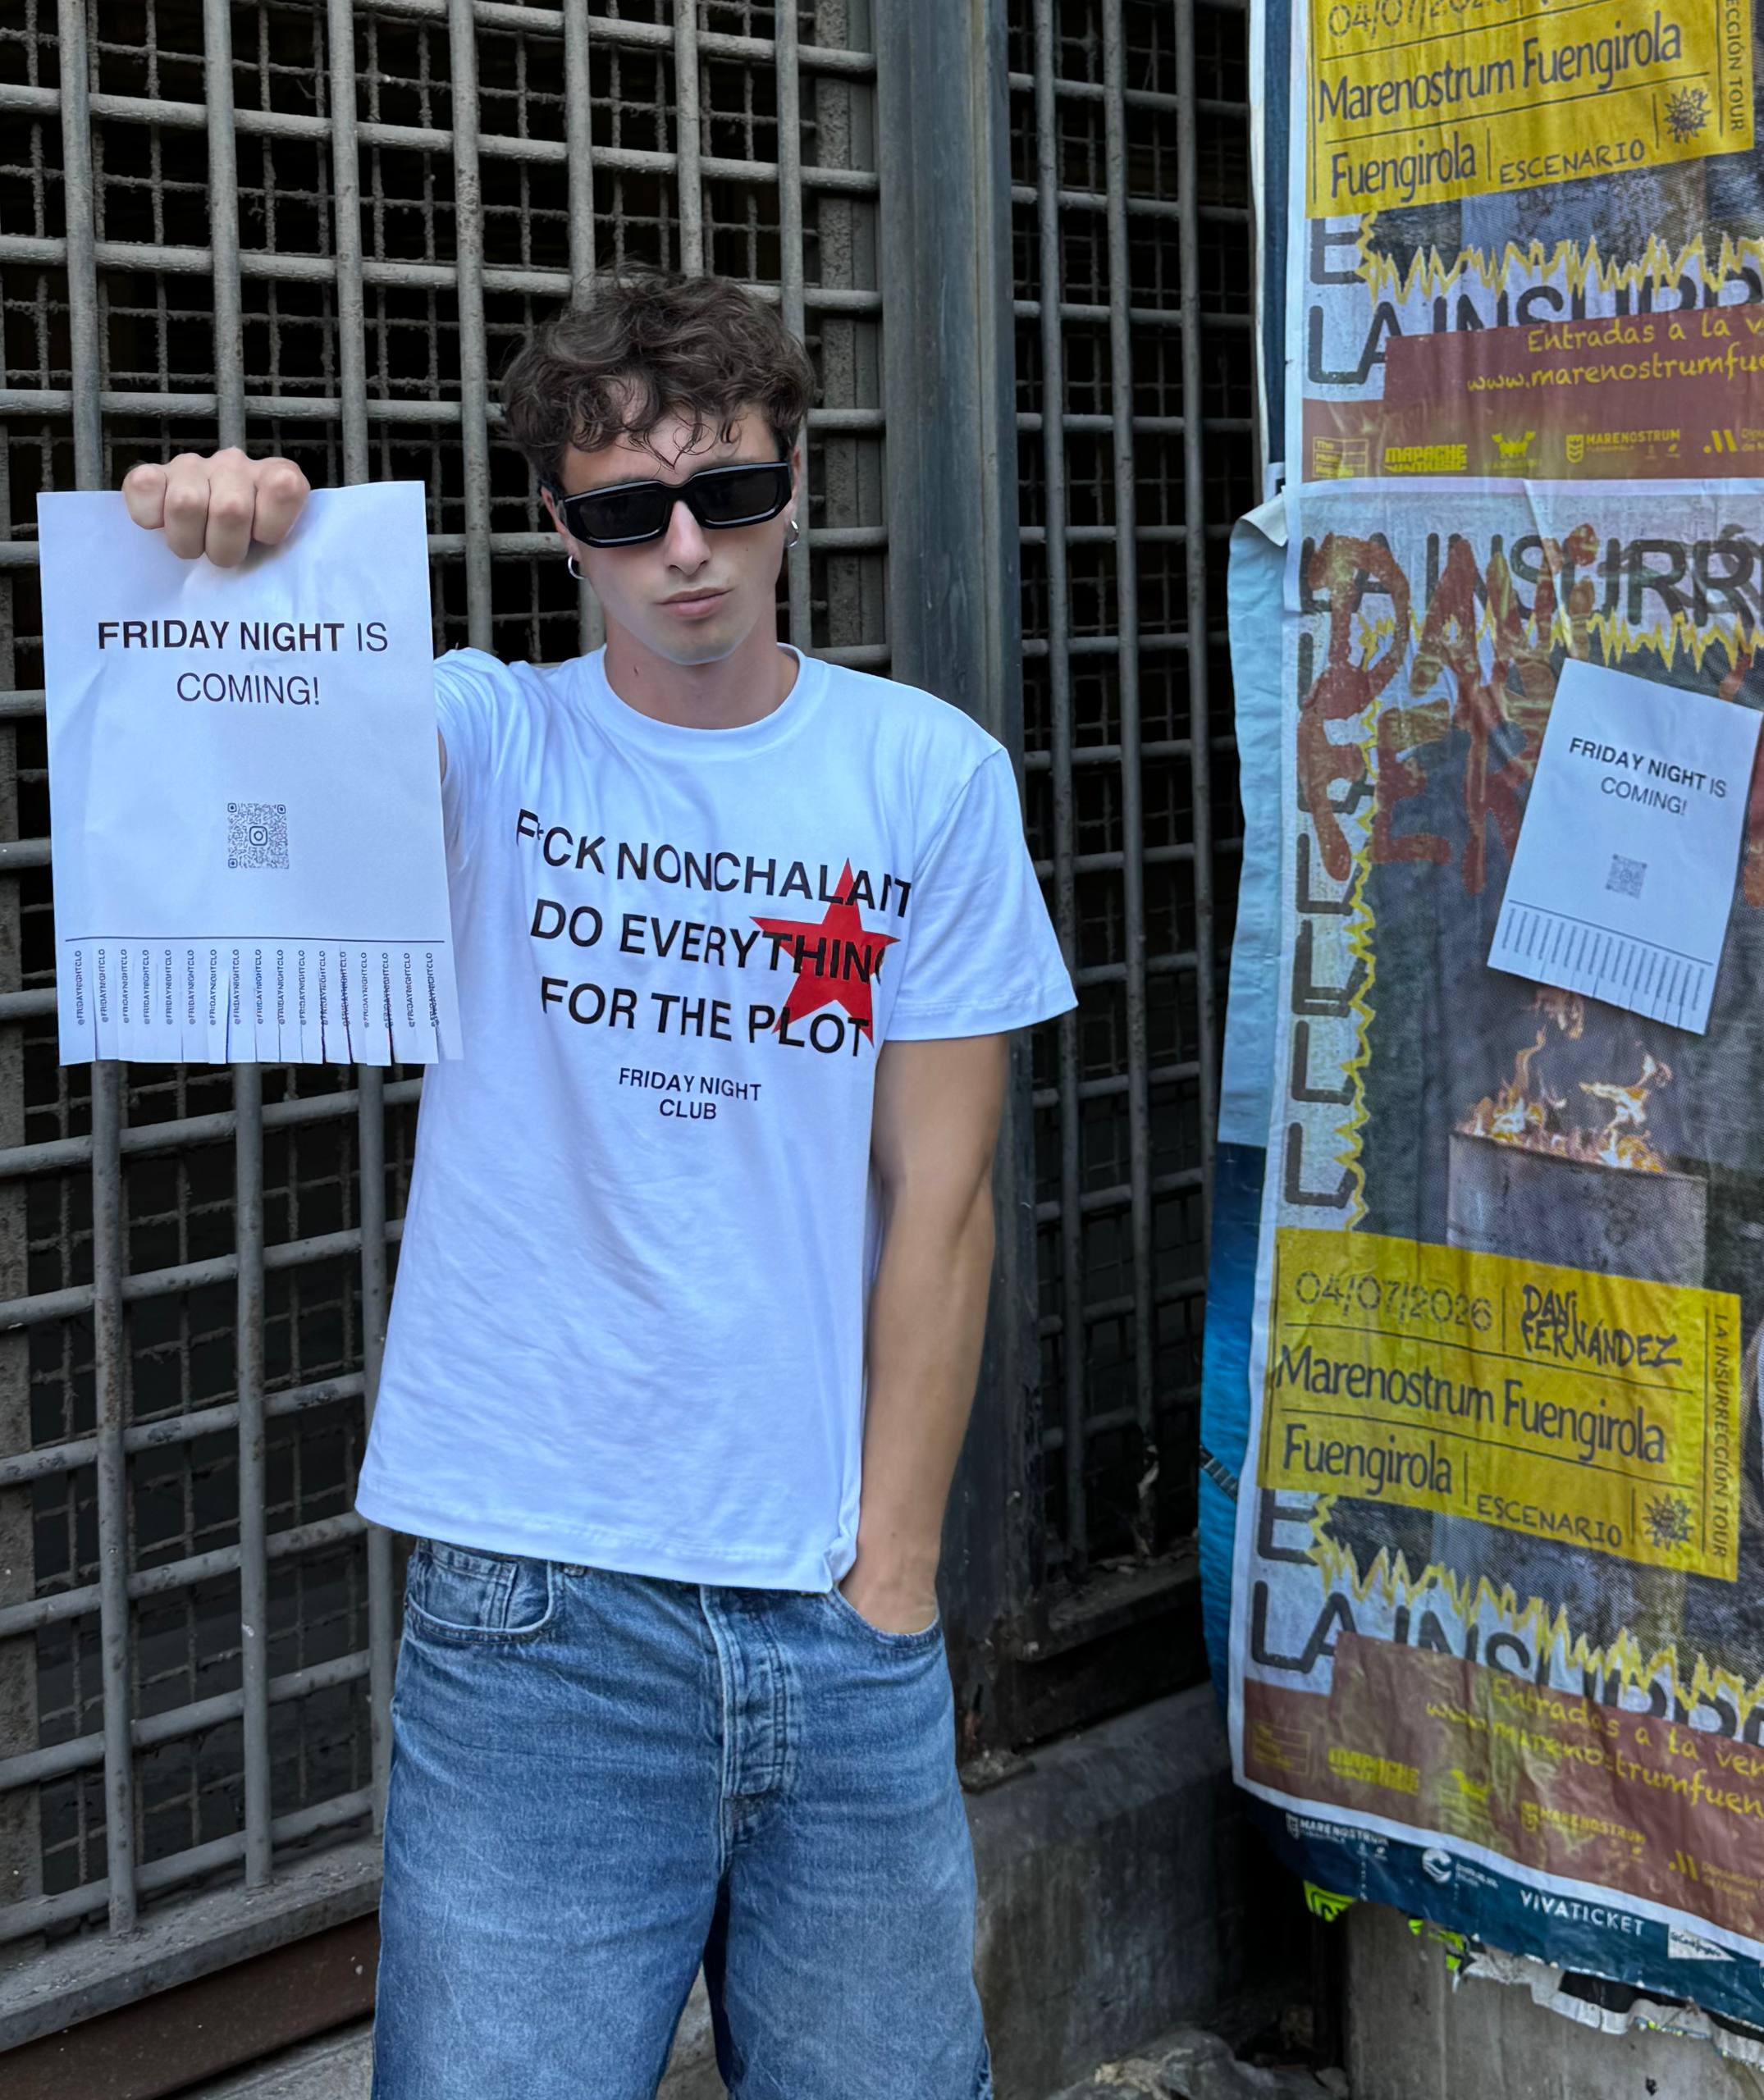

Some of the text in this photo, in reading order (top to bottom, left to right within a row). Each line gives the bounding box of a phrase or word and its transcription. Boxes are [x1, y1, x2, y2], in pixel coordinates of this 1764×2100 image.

[1318, 10, 1681, 123] Marenostrum Fuengirola
[1728, 76, 1745, 131] TOUR
[1331, 131, 1645, 203] Fuengirola ESCENARIO
[1528, 318, 1655, 353] Entradas
[1669, 322, 1686, 340] a
[1702, 313, 1731, 338] la
[1587, 429, 1680, 444] MARENOSTRUM
[98, 620, 389, 652] FRIDAY NIGHT IS
[176, 671, 321, 706] COMING!
[1570, 737, 1726, 798] FRIDAY NIGHT IS
[1600, 775, 1688, 817] COMING!
[529, 898, 604, 947] DO
[541, 976, 870, 1058] FOR THE PLOT
[619, 1067, 761, 1102] FRIDAY NIGHT
[659, 1099, 717, 1121] CLUB
[1295, 1270, 1492, 1331] 04/07/2026
[1273, 1344, 1665, 1464] Marenostrum Fuengirola
[1282, 1423, 1622, 1549] Fuengirola ESCENARIO
[1713, 1504, 1728, 1558] TOUR
[1635, 1728, 1653, 1747] a
[1668, 1728, 1698, 1760] la
[1520, 1889, 1645, 1937] VIVATICKET
